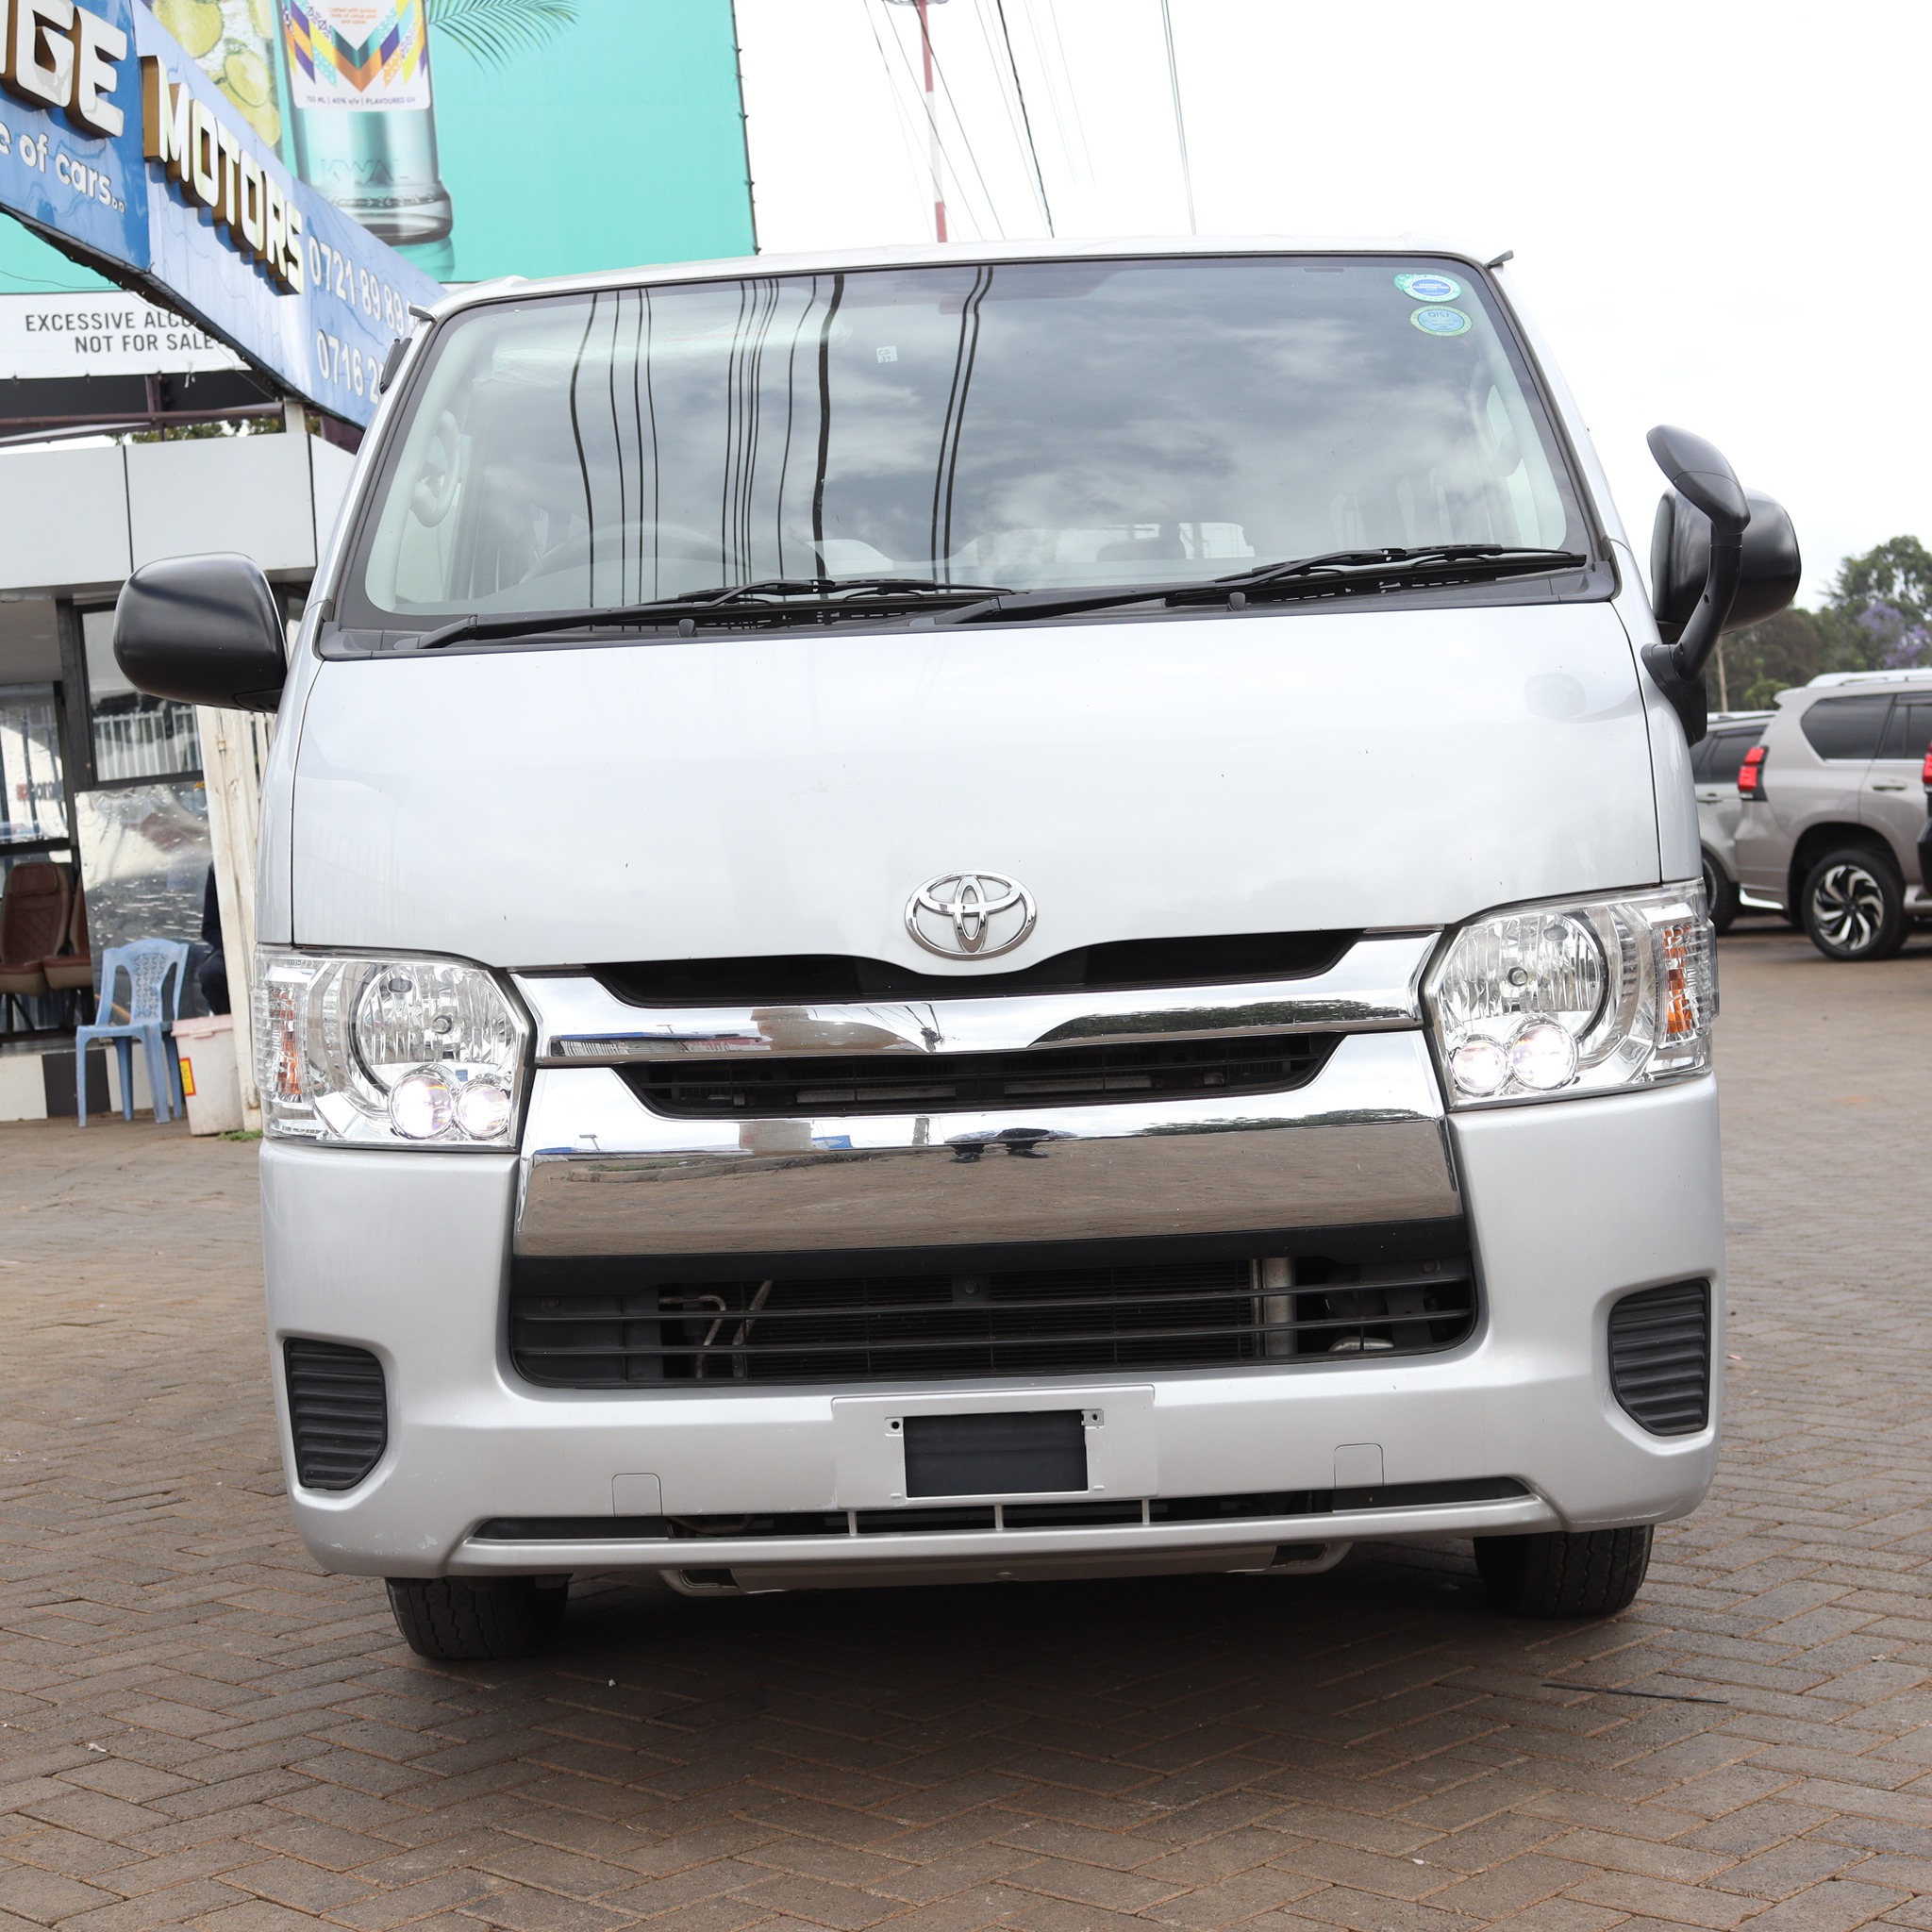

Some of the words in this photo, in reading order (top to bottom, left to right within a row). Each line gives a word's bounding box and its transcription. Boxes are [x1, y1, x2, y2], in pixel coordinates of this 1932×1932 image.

[365, 96, 405, 105] FLAVOURED
[0, 0, 127, 137] GE
[146, 55, 304, 294] MOTORS
[19, 133, 48, 173] of
[308, 236, 357, 307] 0721
[359, 268, 382, 322] 89
[384, 284, 405, 336] 89
[25, 312, 136, 332] EXCESSIVE
[75, 336, 113, 354] NOT
[123, 334, 158, 352] FOR
[166, 332, 214, 351] SALE
[317, 329, 364, 397] 0716
[367, 356, 385, 405] 2
